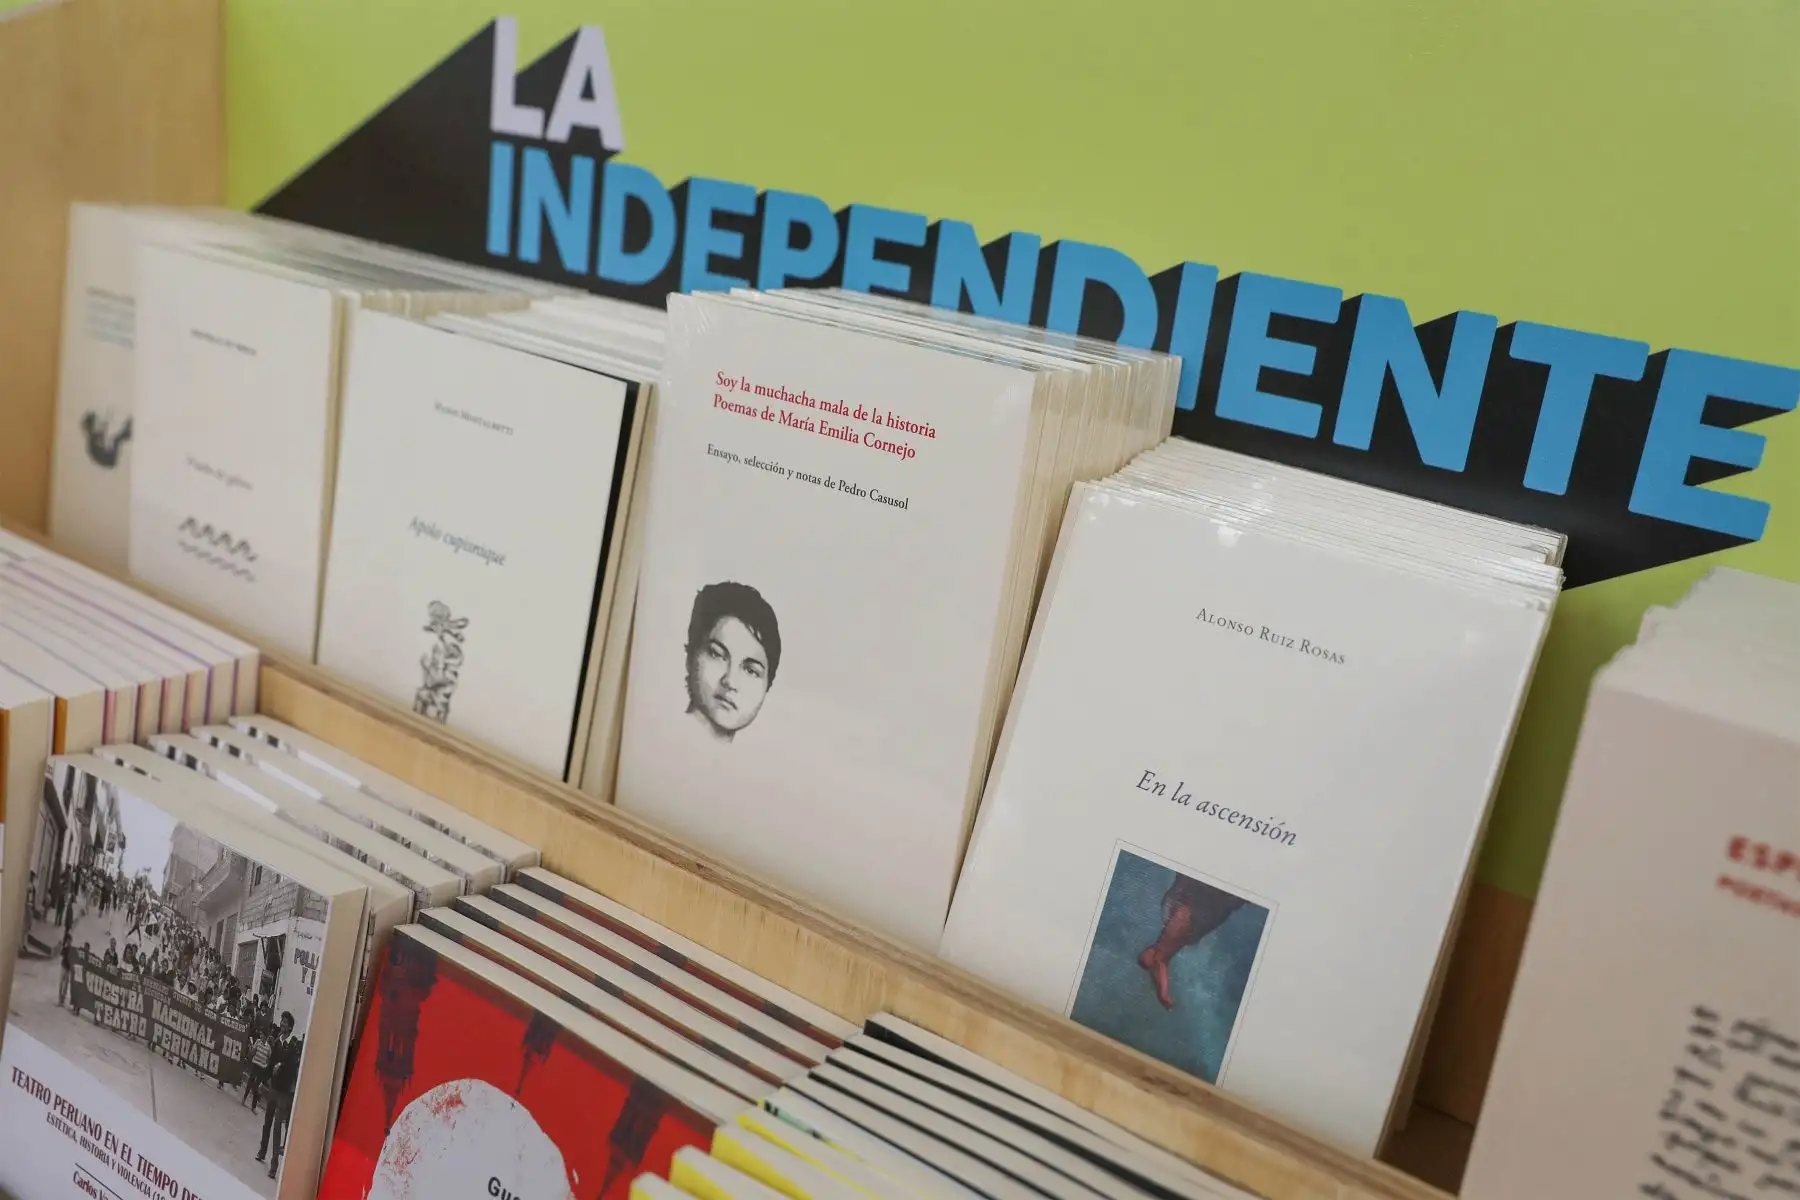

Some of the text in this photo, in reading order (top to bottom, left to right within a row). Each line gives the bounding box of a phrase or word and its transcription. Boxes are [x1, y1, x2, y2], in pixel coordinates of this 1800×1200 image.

[490, 15, 624, 152] LA
[486, 142, 1800, 541] INDEPENDIENTE
[713, 394, 916, 461] Poemas de María Emilia Cornejo
[716, 371, 936, 439] Soy la muchacha mala de la historia
[707, 443, 909, 510] Ensayo, selección y notas de Pedro Casusol
[1136, 769, 1297, 847] En la ascensión
[94, 1001, 147, 1038] TEATRO
[152, 1022, 220, 1075] PERUANO
[152, 1000, 216, 1050] NACIONAL
[221, 1035, 242, 1062] DE
[11, 1066, 50, 1106] TEATRO
[53, 1093, 102, 1141] PERUANO
[104, 1130, 119, 1155] EN
[120, 1142, 133, 1167] EL
[137, 1153, 178, 1198] TIEMPO
[73, 1170, 97, 1199] Carlos
[79, 1135, 110, 1167] HISTORIA
[111, 1159, 116, 1171] Y
[117, 1162, 151, 1198] VIOLENCIA
